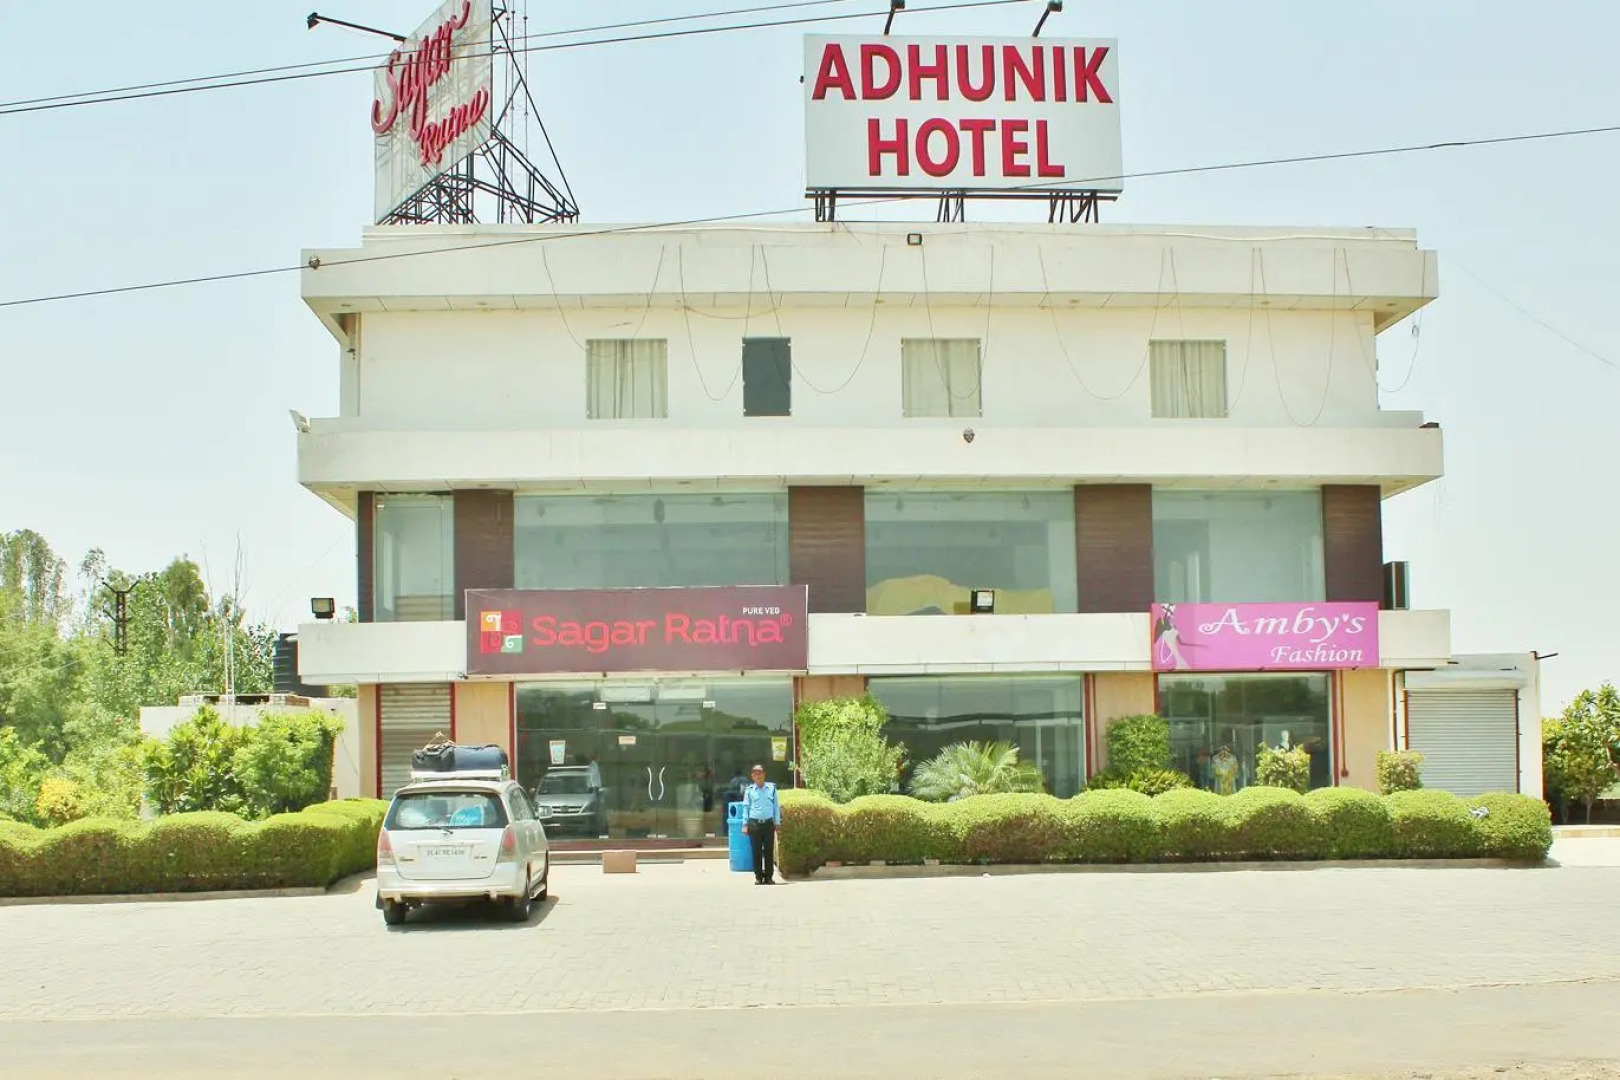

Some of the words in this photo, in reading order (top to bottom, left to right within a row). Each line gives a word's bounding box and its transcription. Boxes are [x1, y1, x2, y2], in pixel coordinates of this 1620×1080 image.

[812, 43, 1114, 104] ADHUNIK
[867, 117, 1066, 178] HOTEL
[742, 606, 764, 615] PURE
[1198, 606, 1367, 643] Amby's
[532, 615, 657, 652] Sagar
[1270, 643, 1364, 664] Fashion
